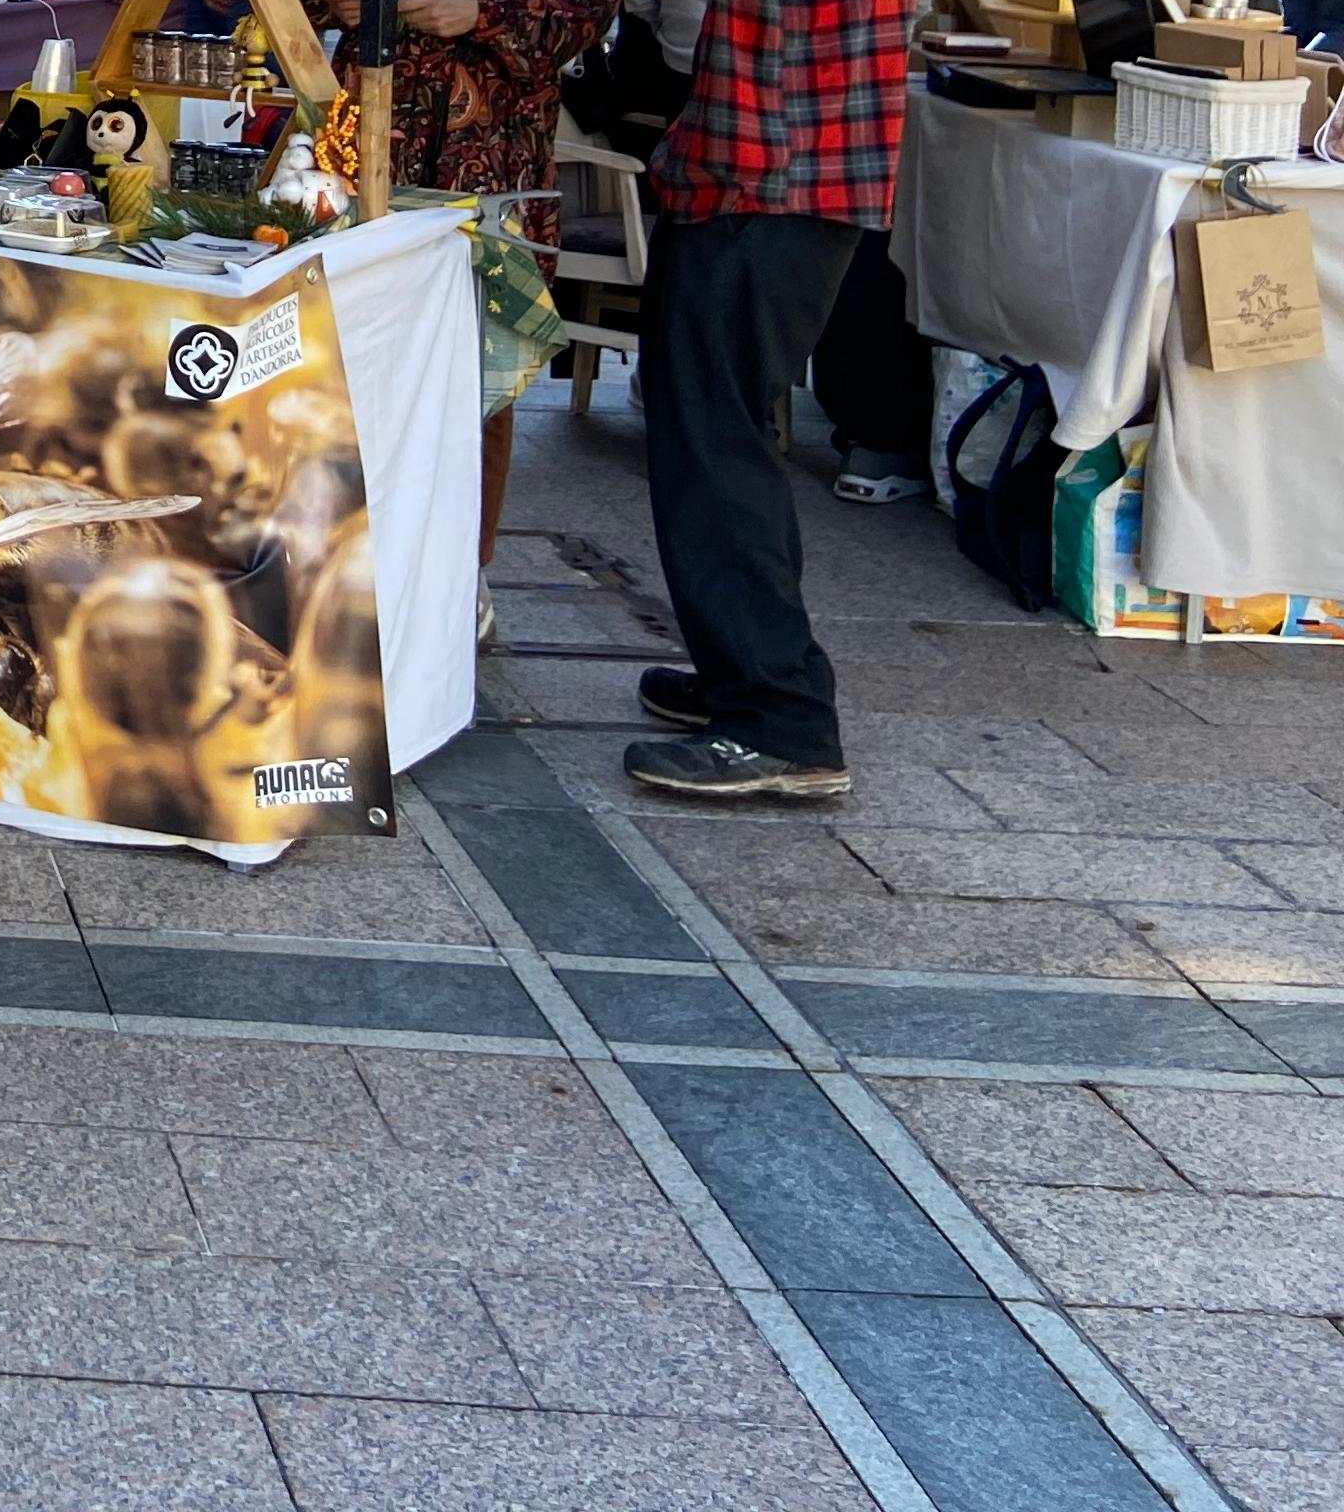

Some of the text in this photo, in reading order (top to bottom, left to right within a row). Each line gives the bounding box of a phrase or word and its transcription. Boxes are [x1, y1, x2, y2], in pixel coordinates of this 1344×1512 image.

[246, 331, 297, 366] ARTESANS
[240, 348, 302, 386] D'ANDORRA
[255, 789, 353, 808] EMOTIONS
